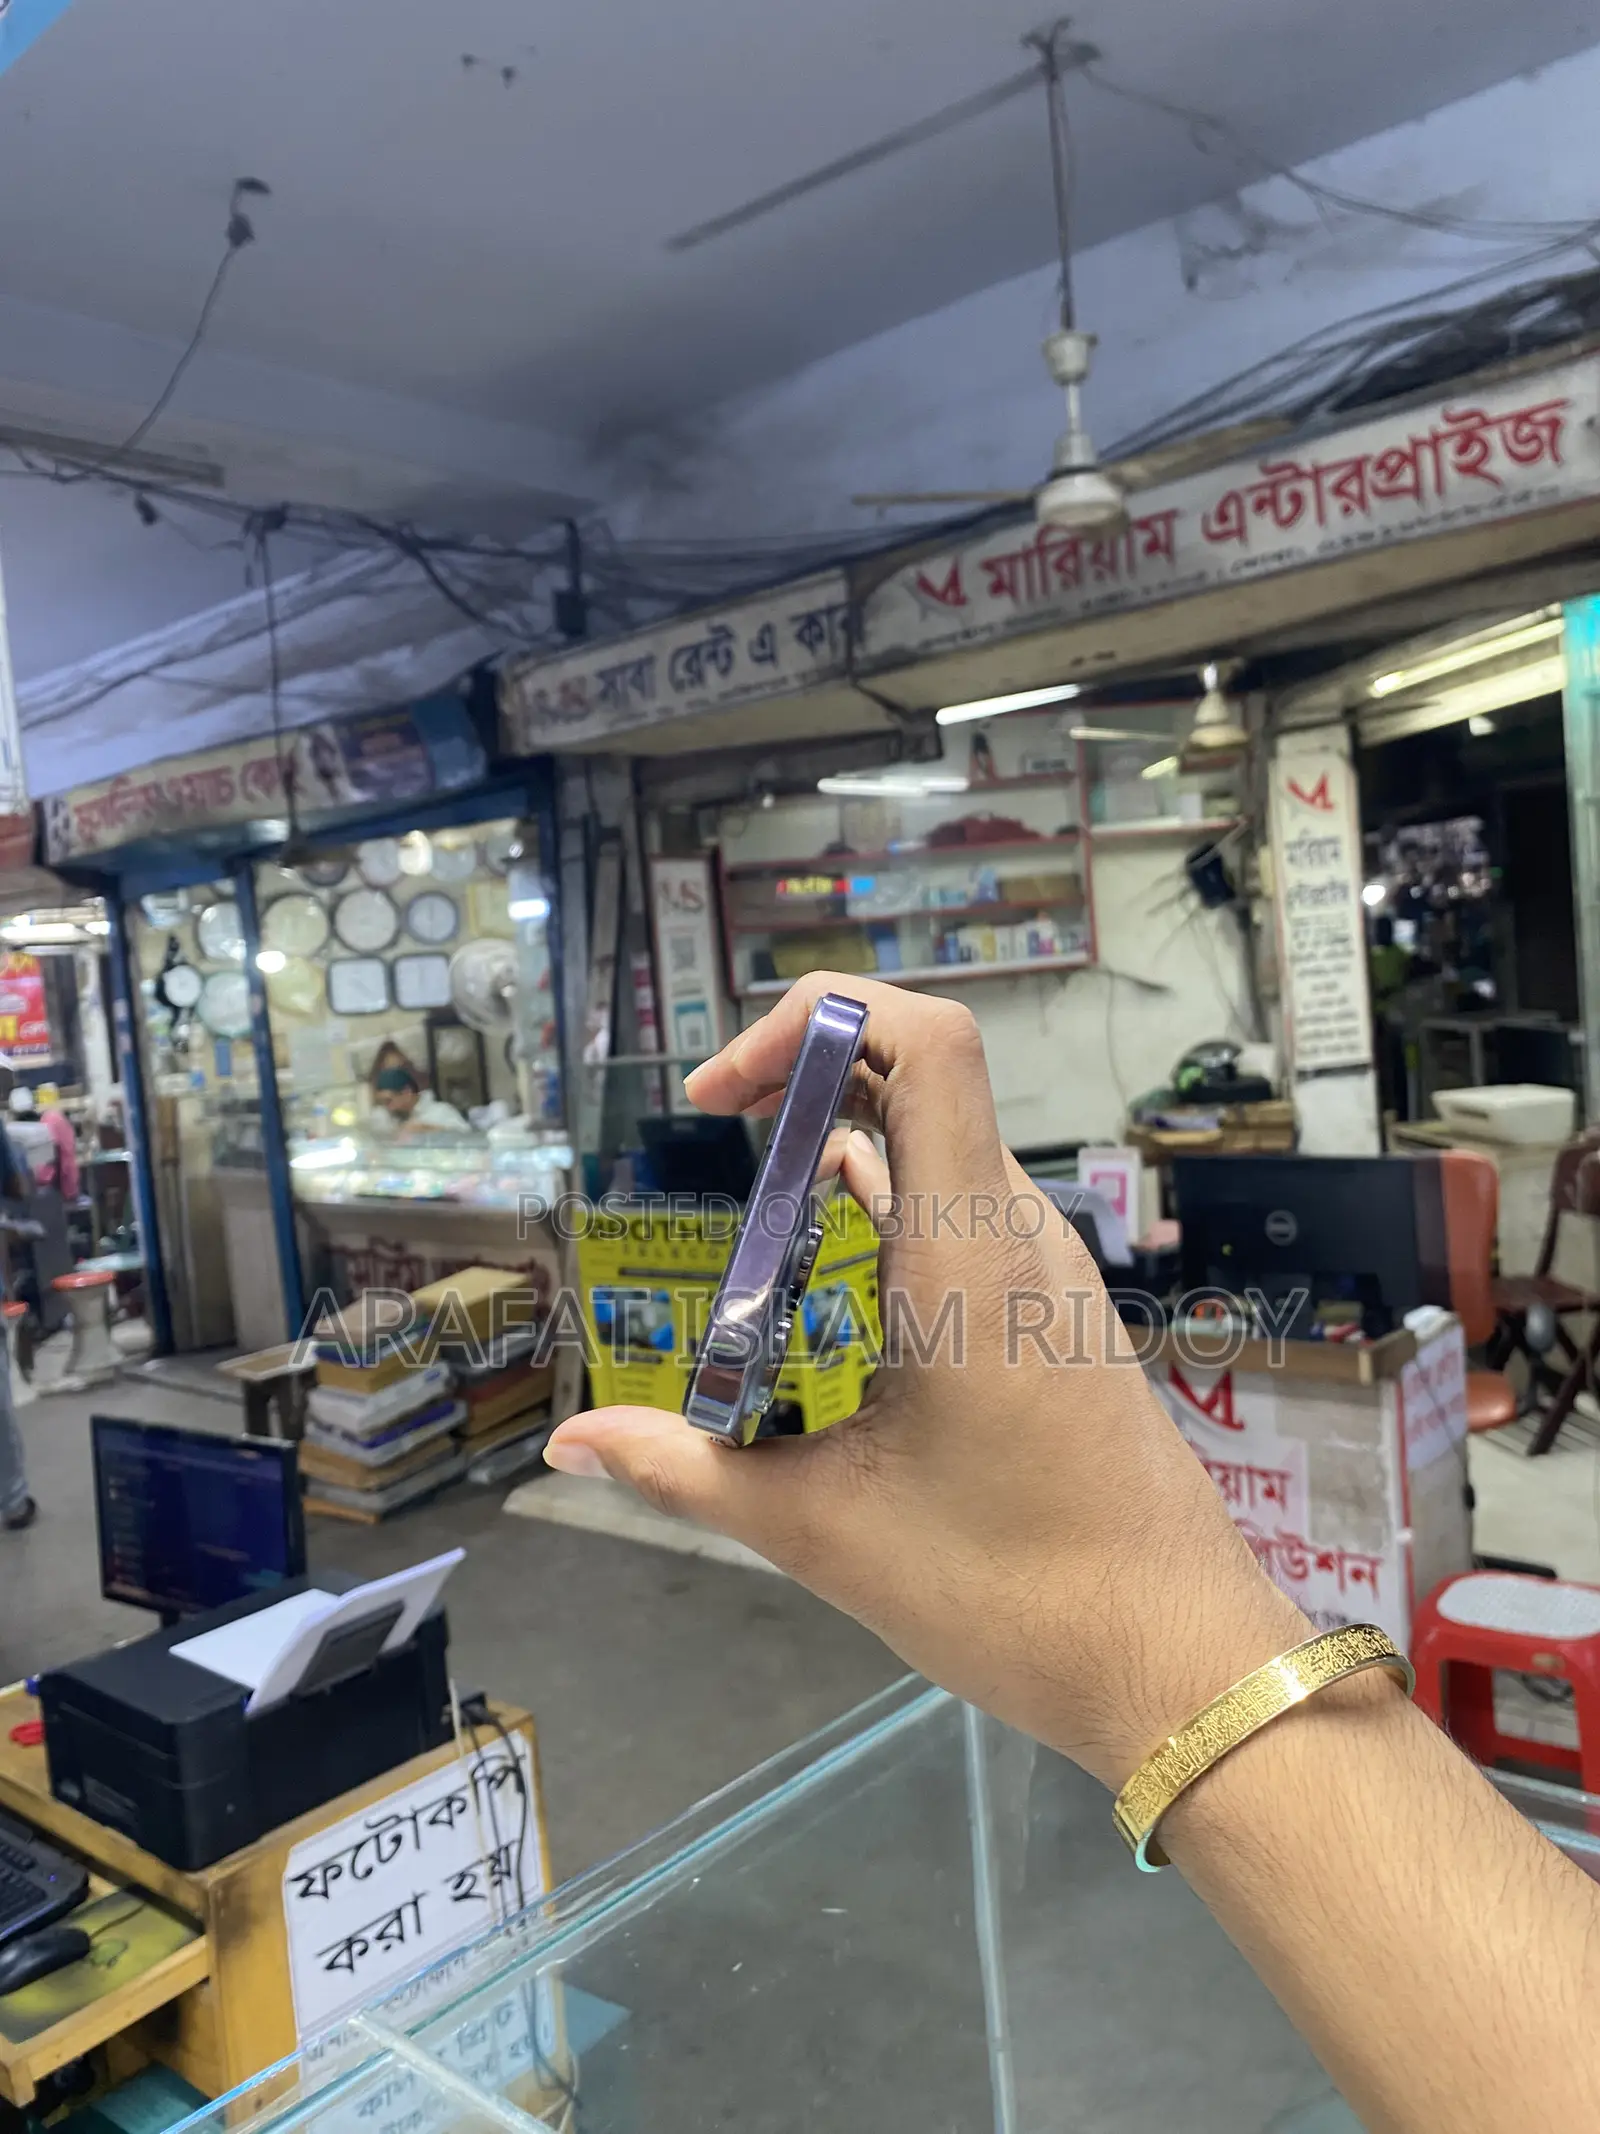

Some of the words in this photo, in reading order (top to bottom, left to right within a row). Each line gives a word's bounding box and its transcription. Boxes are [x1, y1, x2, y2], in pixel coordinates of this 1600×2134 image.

[1201, 399, 1570, 544] এন্টারপ্রাইজ
[748, 621, 780, 668] এ
[287, 1752, 527, 1900] ফটোকপি
[315, 1890, 428, 1974] করা
[442, 1839, 519, 1903] হয়
